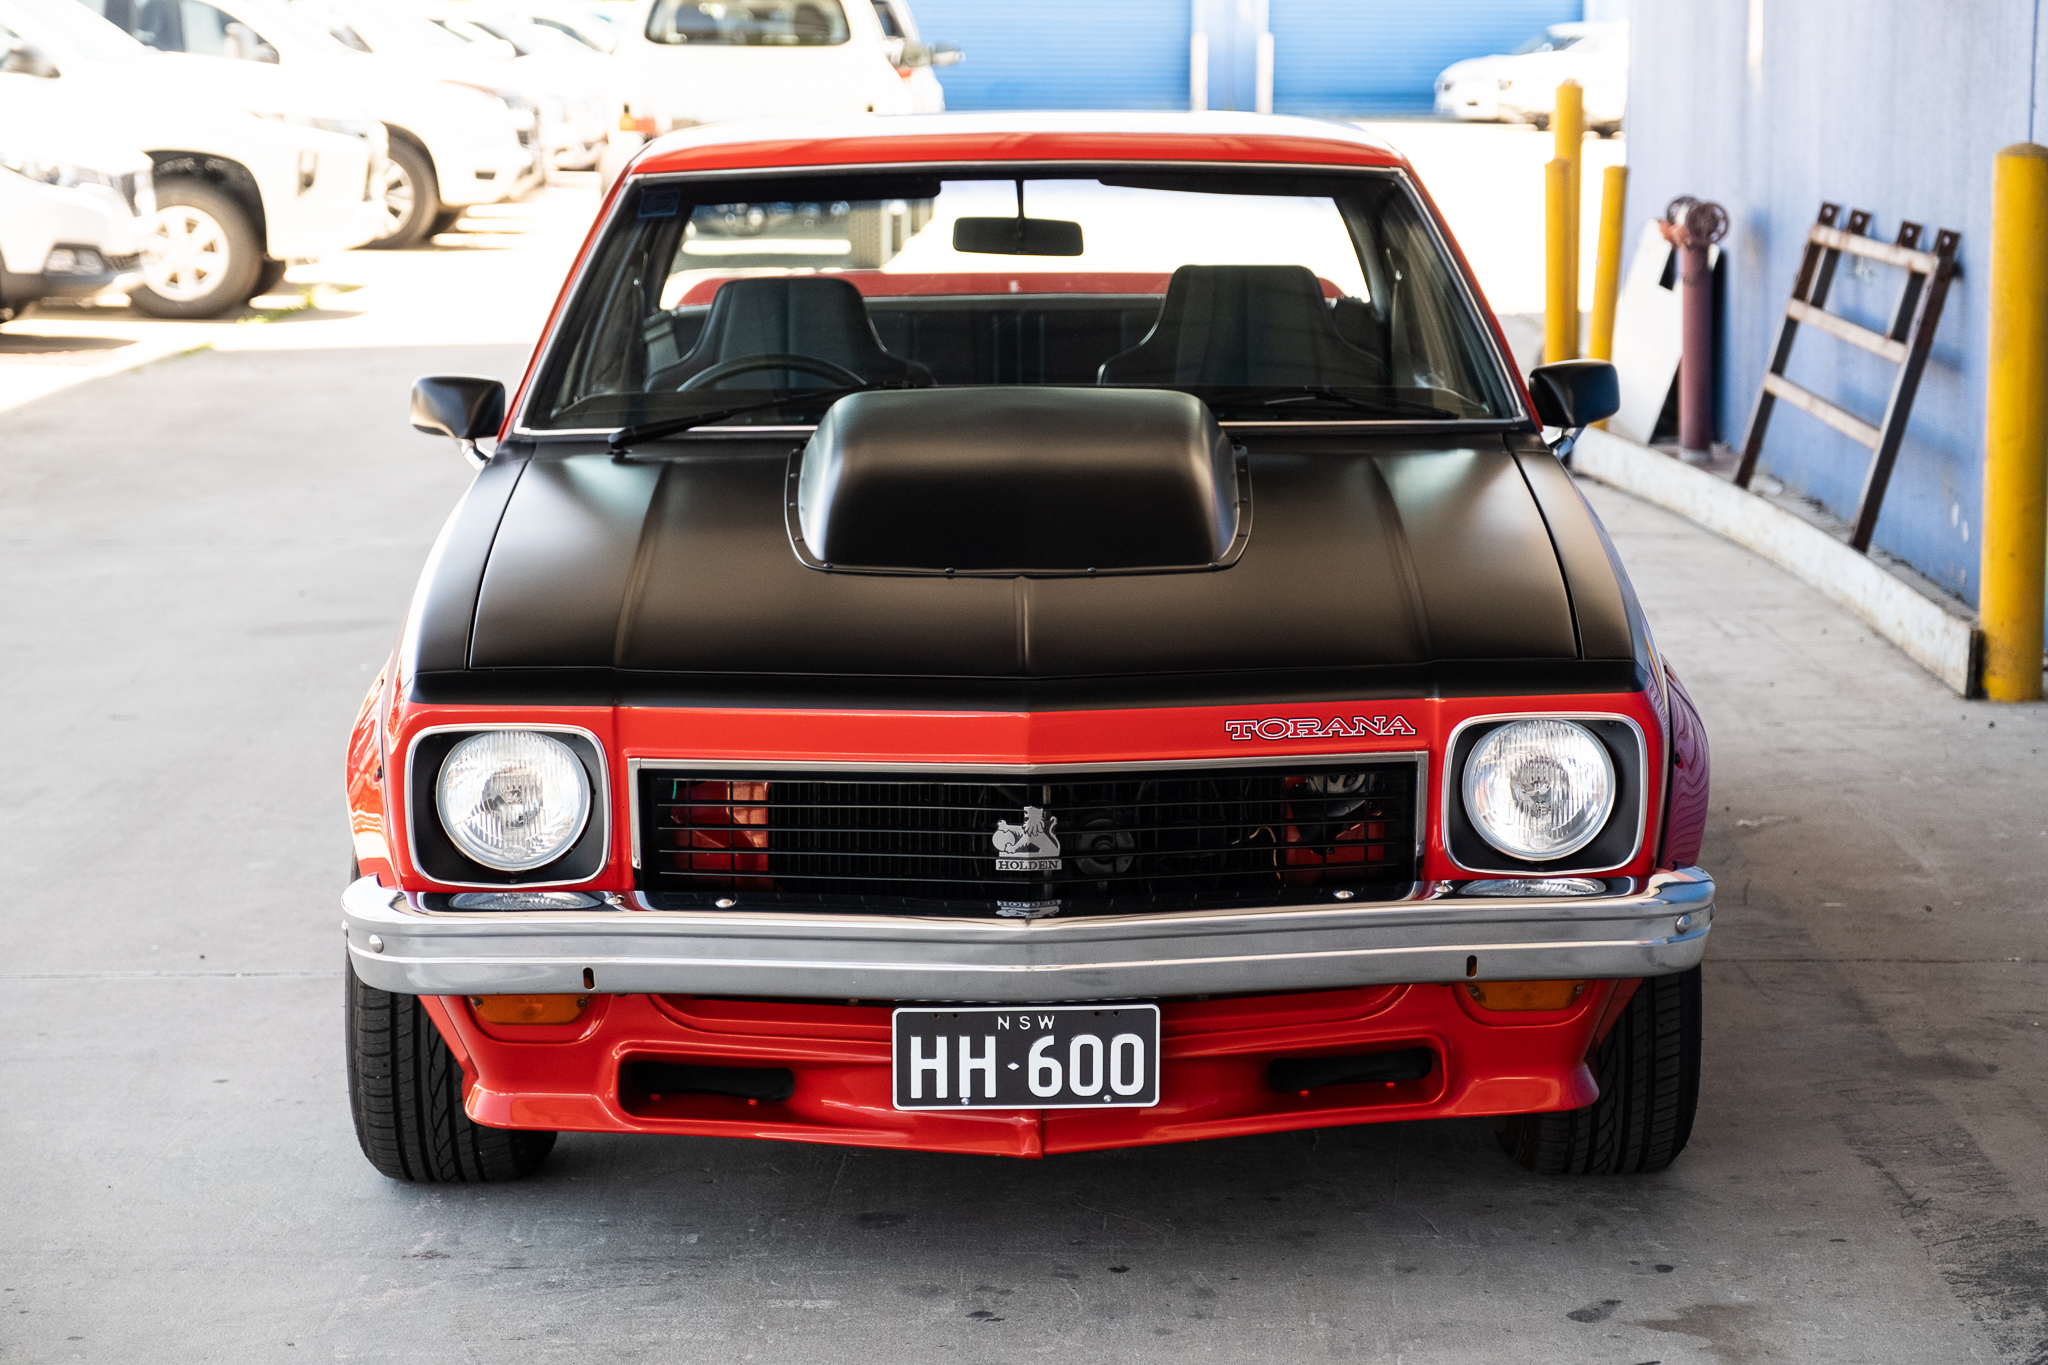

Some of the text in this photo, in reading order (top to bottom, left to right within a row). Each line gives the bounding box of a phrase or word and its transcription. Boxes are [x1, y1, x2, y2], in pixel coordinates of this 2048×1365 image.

[1225, 715, 1417, 740] TORANA
[998, 860, 1059, 870] HOLDEN
[997, 1015, 1055, 1030] NSW
